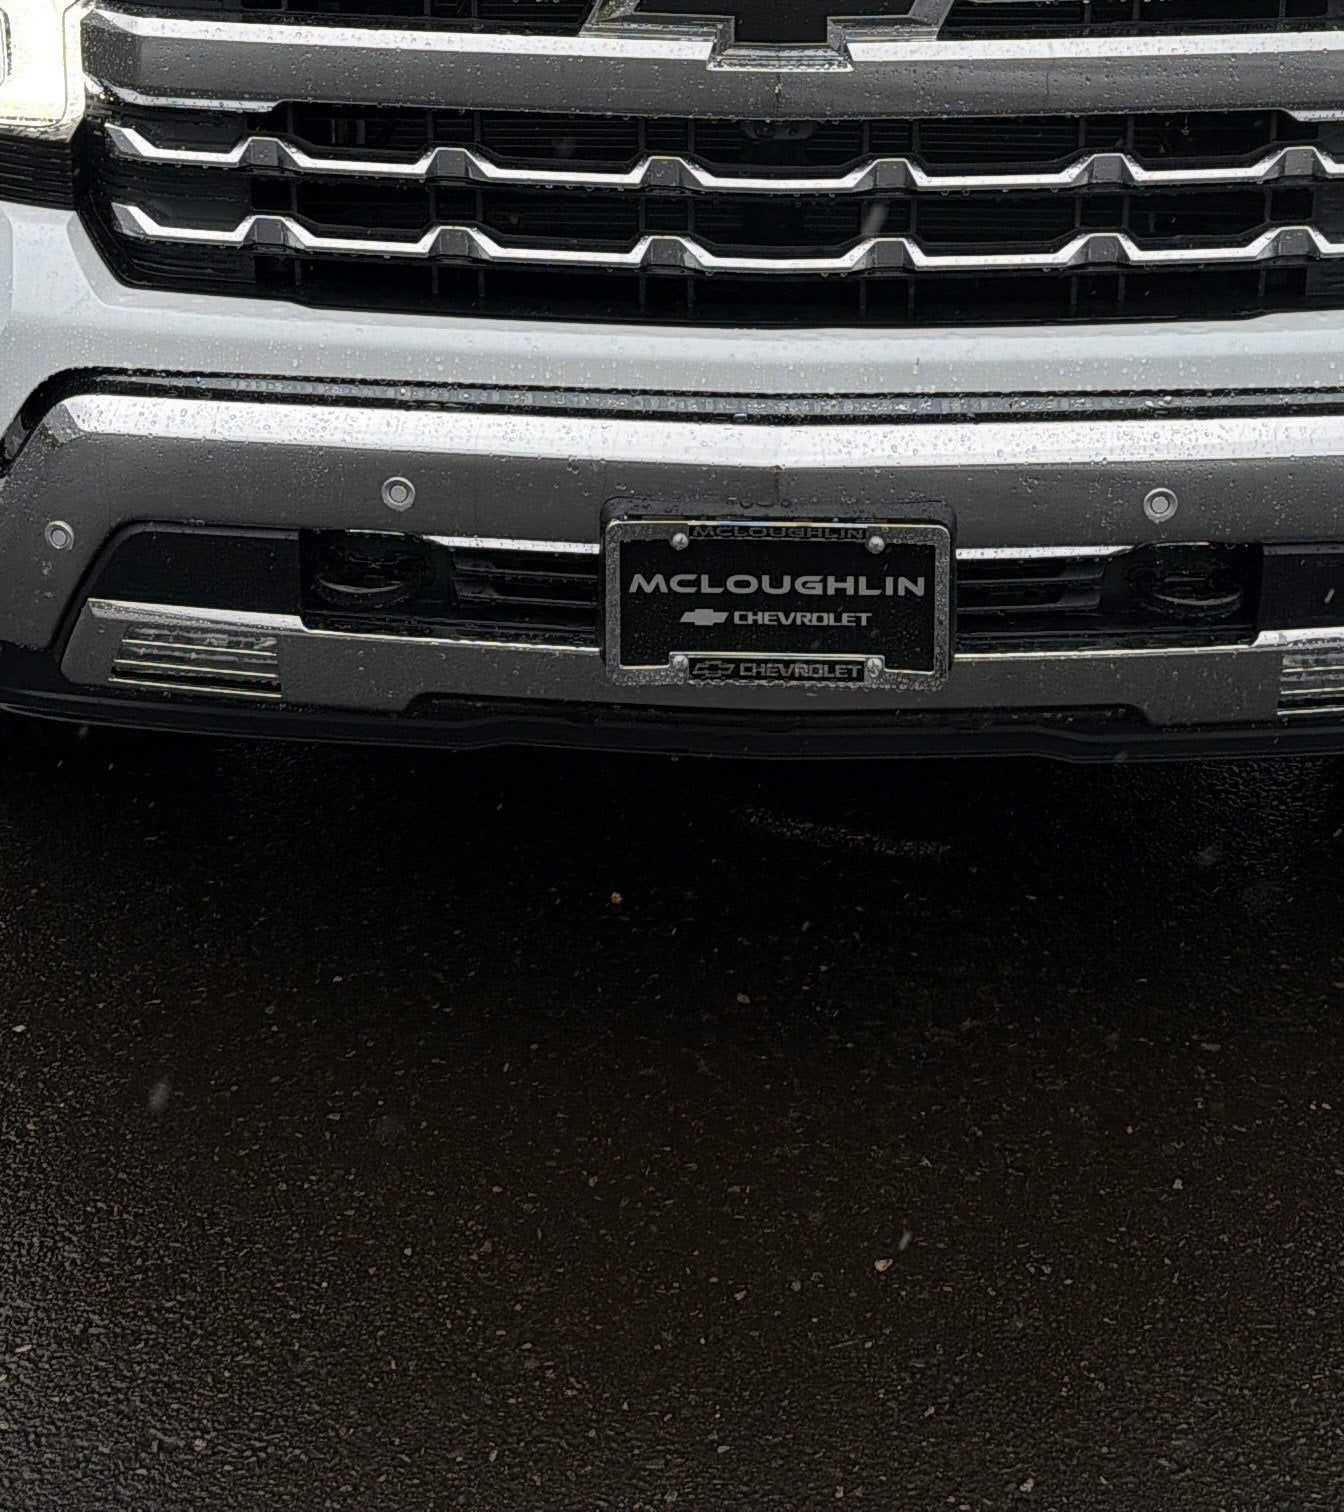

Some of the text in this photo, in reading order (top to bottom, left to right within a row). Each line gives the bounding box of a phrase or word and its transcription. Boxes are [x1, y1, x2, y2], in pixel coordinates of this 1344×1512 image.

[692, 526, 865, 539] MCLOUGHLIN
[628, 573, 926, 597] MCLOUGHLIN
[733, 610, 873, 627] CHEVROLET
[739, 662, 863, 679] CHEVROLET
